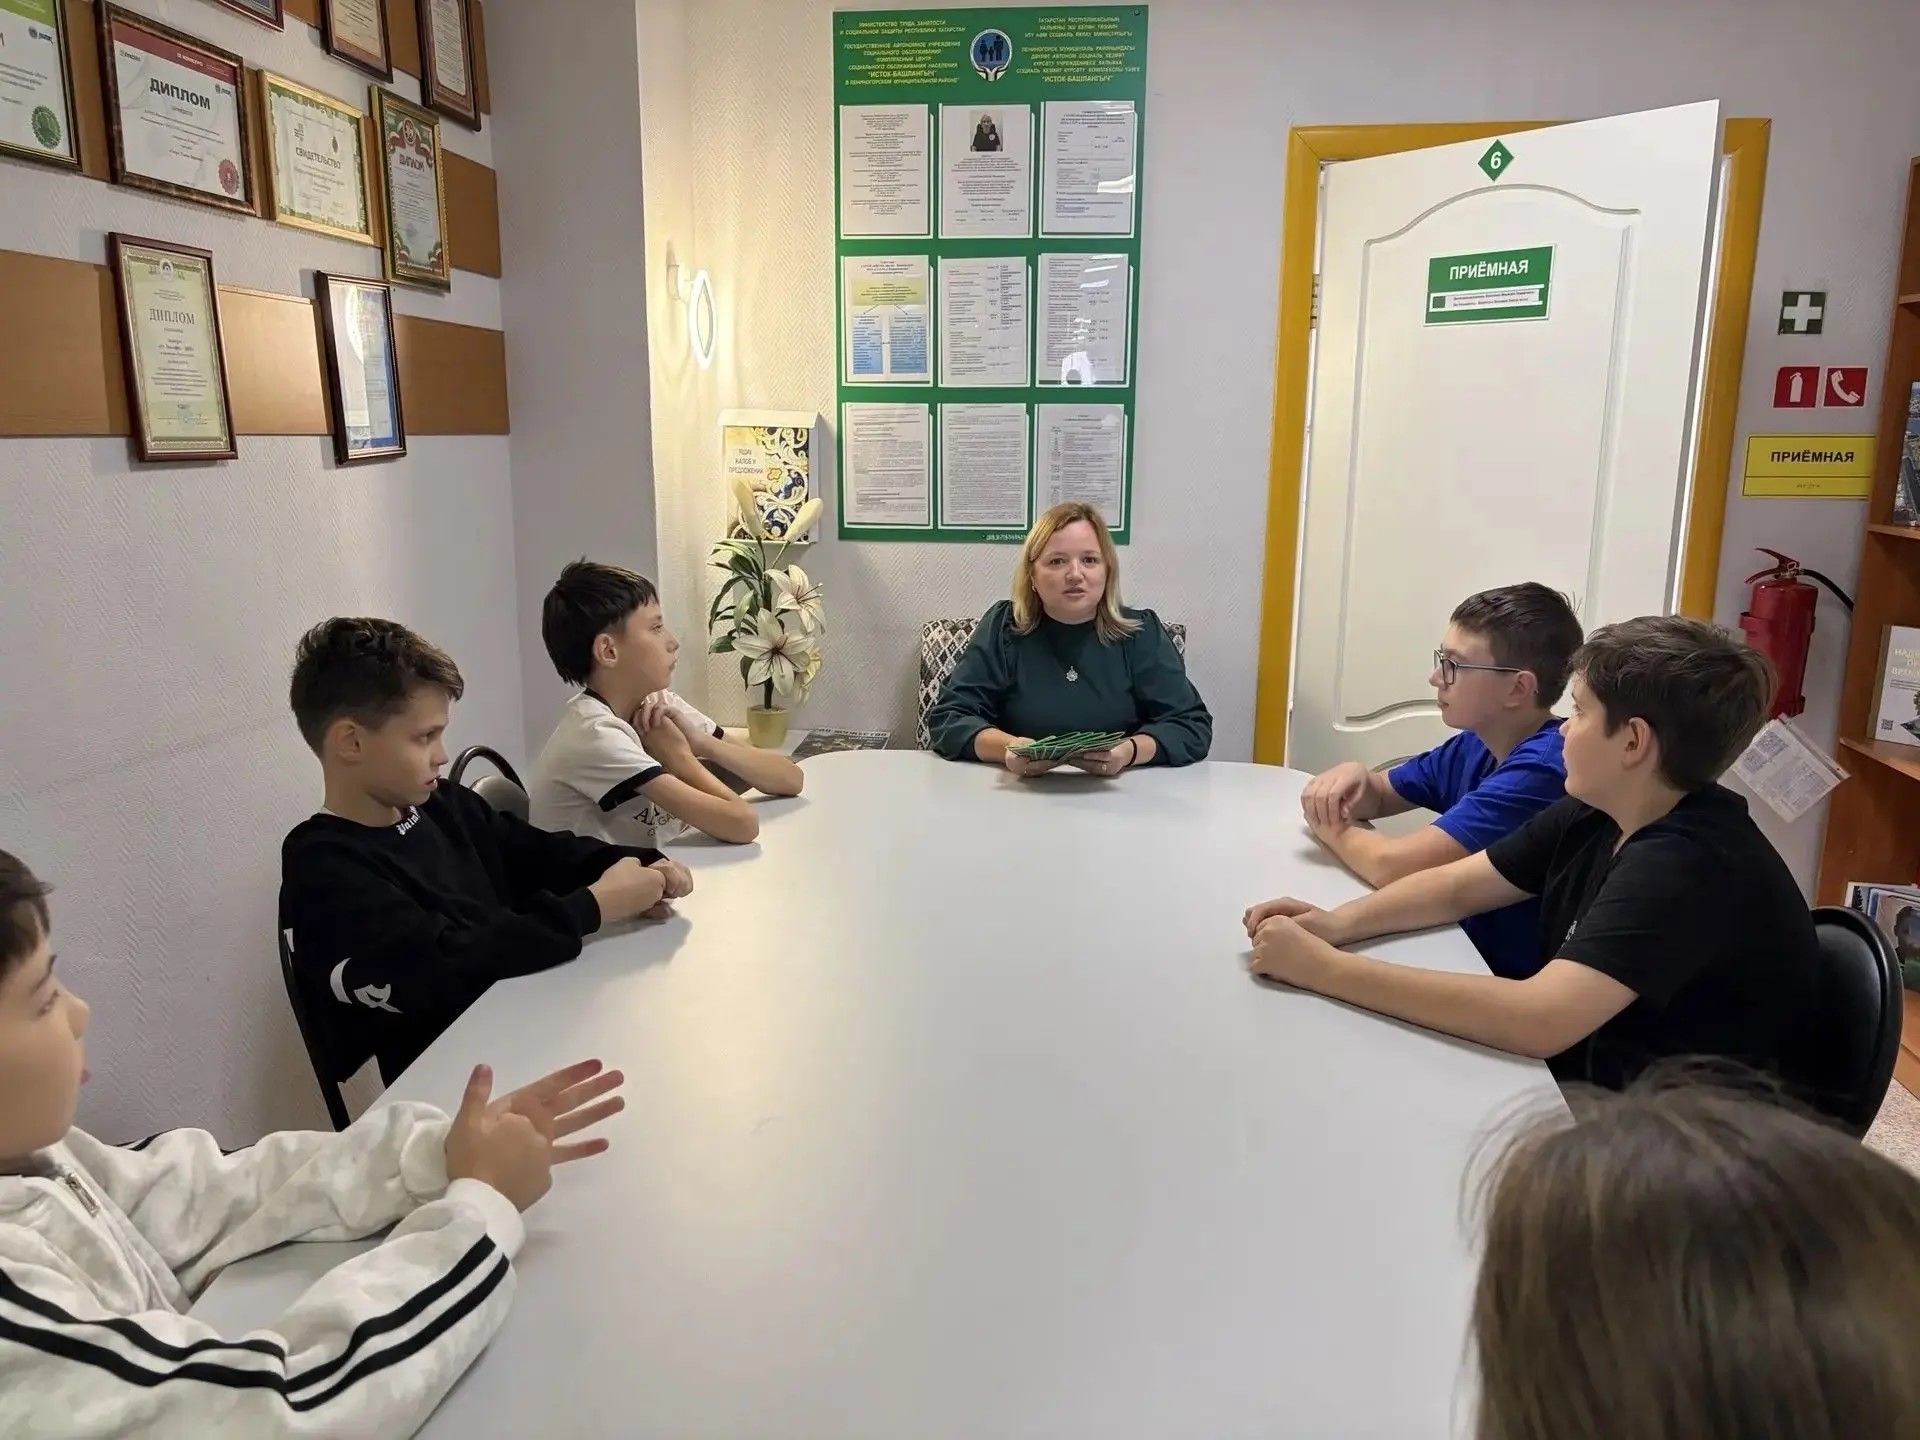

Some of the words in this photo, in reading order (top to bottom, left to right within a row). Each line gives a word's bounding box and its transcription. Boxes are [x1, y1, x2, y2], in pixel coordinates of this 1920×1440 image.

[150, 77, 211, 110] ДИПЛОМ
[295, 147, 341, 169] СВИДЕТЕЛЬСТВО
[399, 153, 425, 172] ДИПЛОМ
[1490, 151, 1502, 169] 6
[1449, 259, 1529, 280] ПРИЁМНАЯ
[149, 308, 195, 325] ДИПЛОМ
[1770, 450, 1855, 463] ПРИЁМНАЯ
